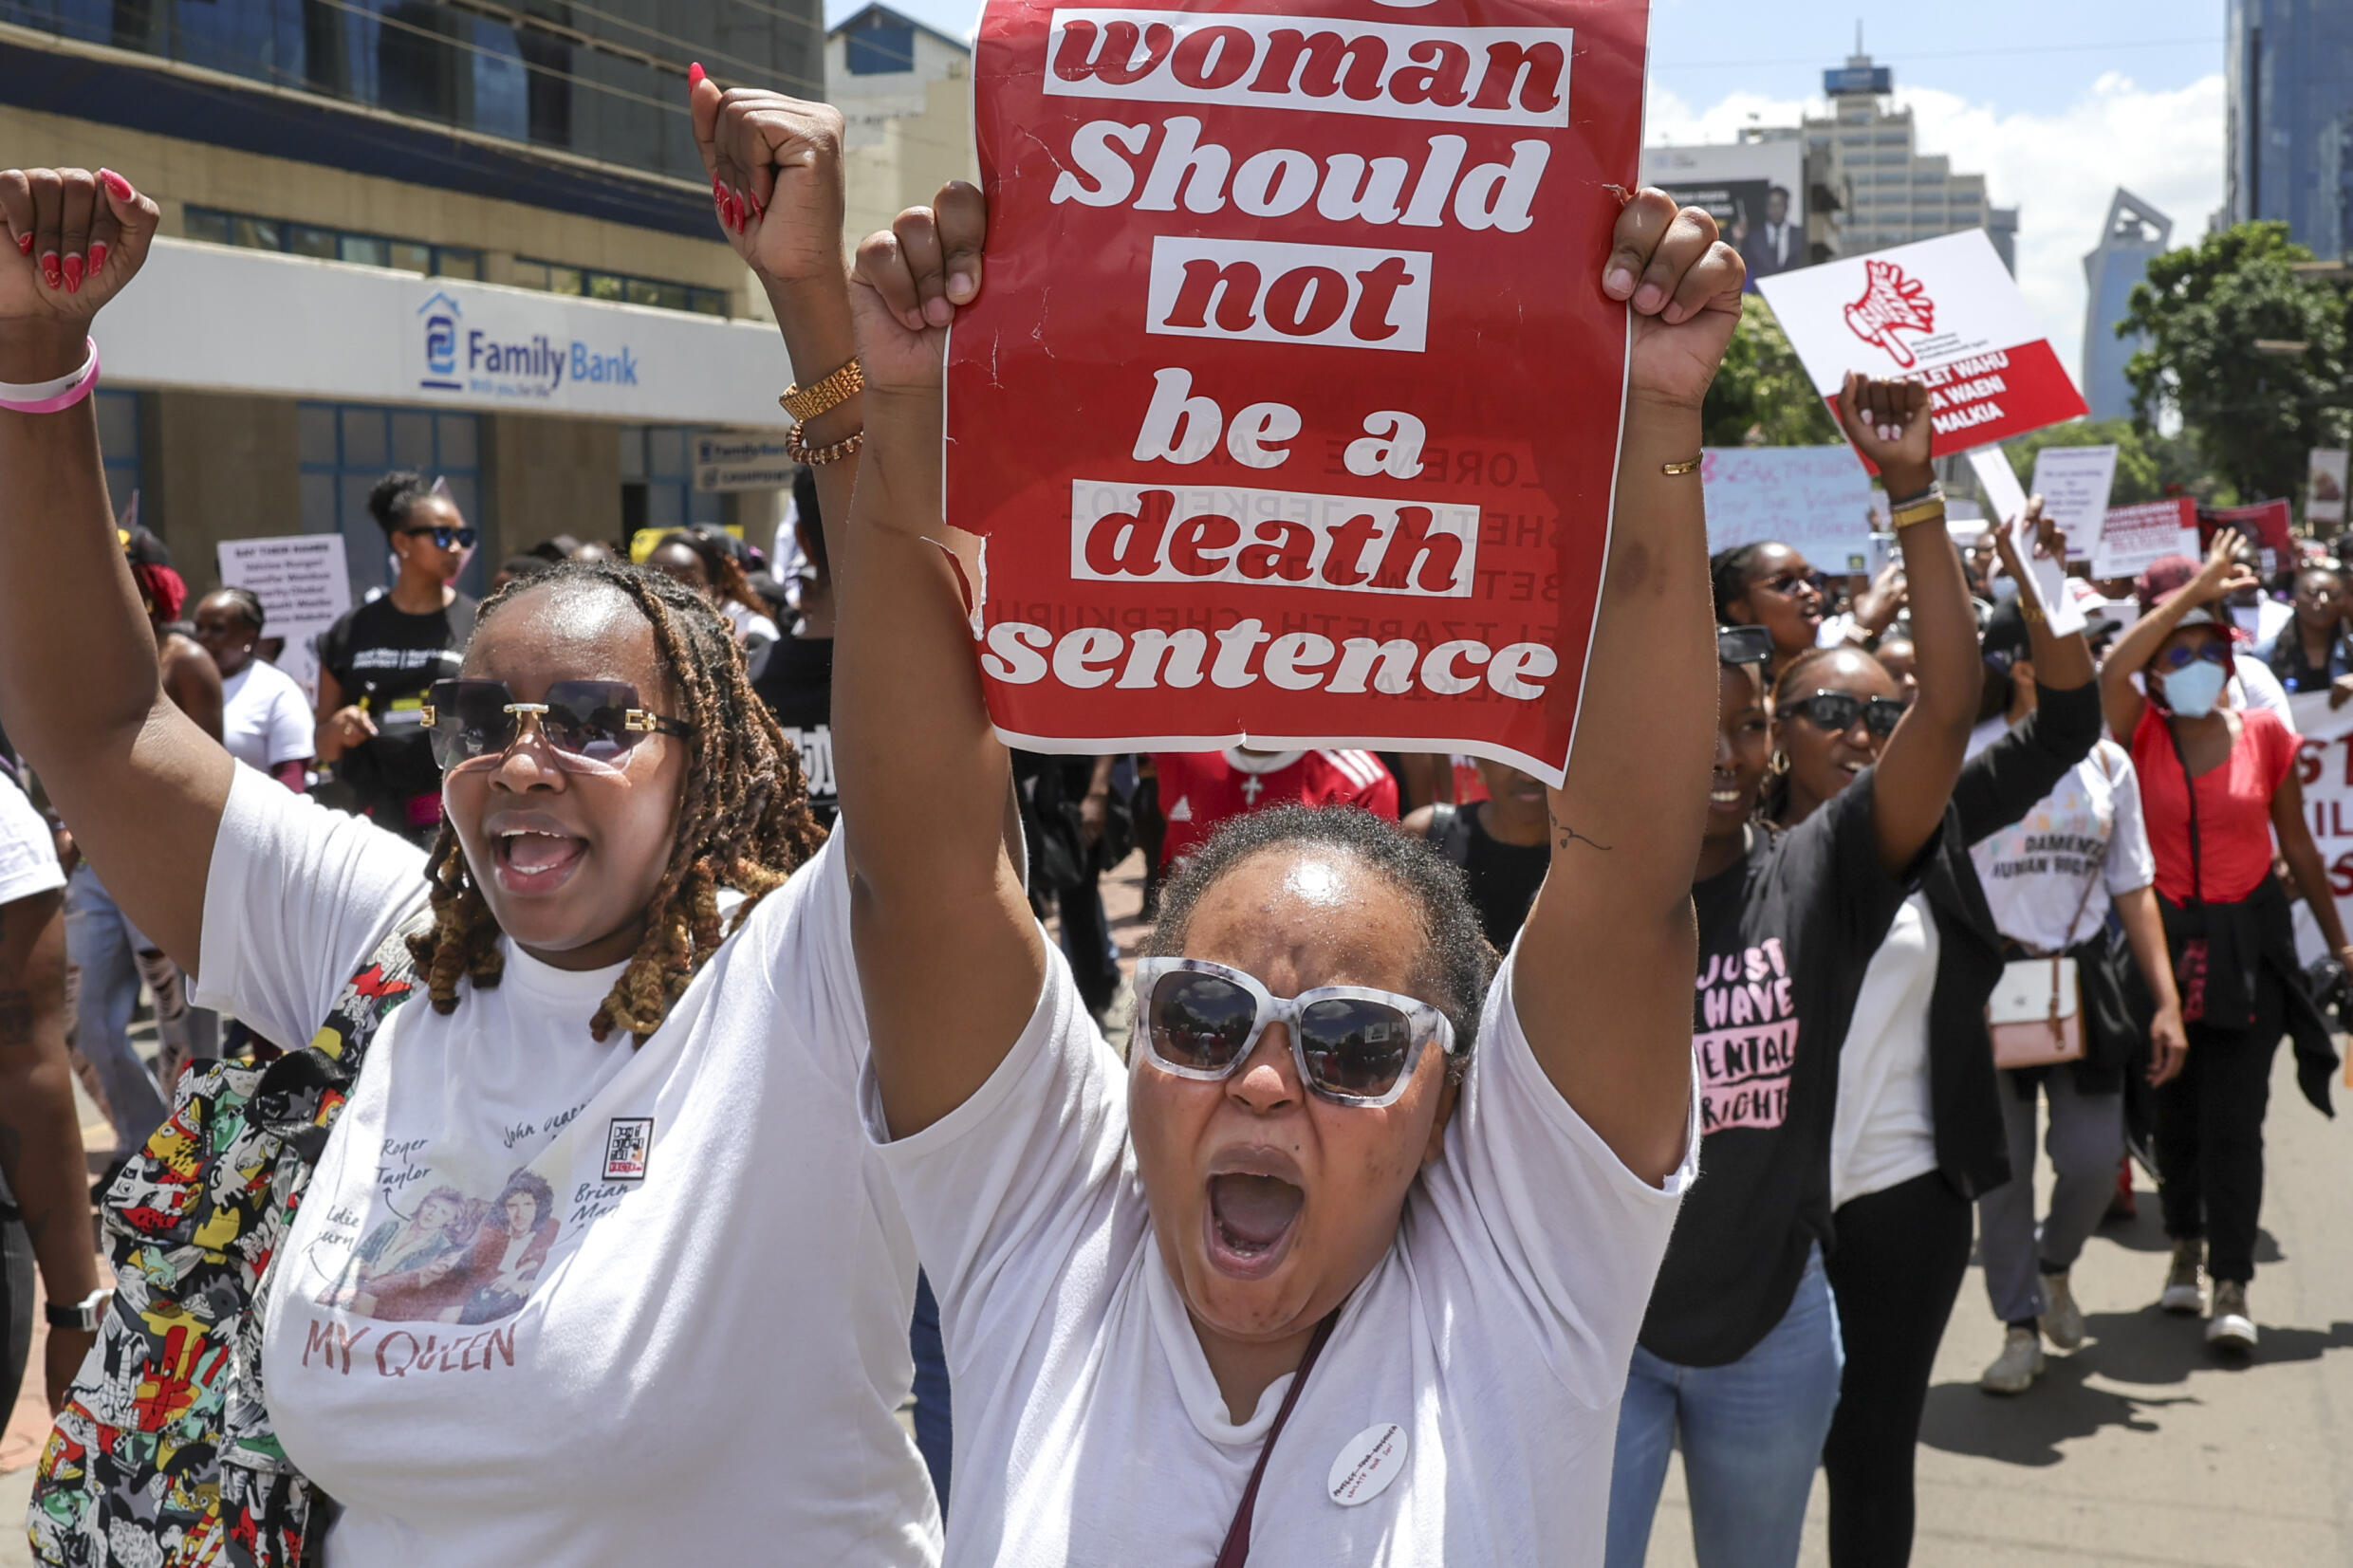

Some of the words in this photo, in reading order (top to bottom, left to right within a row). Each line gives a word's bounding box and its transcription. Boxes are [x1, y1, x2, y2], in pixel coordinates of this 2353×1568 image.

[1052, 18, 1562, 114] woman
[1050, 115, 1551, 233] Should
[1163, 256, 1415, 341] not
[1944, 375, 2007, 405] WAENI
[1953, 351, 2010, 378] WAHU
[1132, 367, 1302, 470] be
[1343, 410, 1426, 480] a
[1931, 401, 2004, 435] MALKIA
[1084, 489, 1464, 593] death
[981, 618, 1559, 701] sentence
[1695, 937, 1786, 990] JUST
[1703, 977, 1794, 1028] HAVE
[377, 1166, 433, 1188] Taylor
[380, 1138, 429, 1164] Roger
[574, 1182, 628, 1203] Brian
[302, 1319, 372, 1376] MY
[375, 1323, 517, 1377] QUEEN
